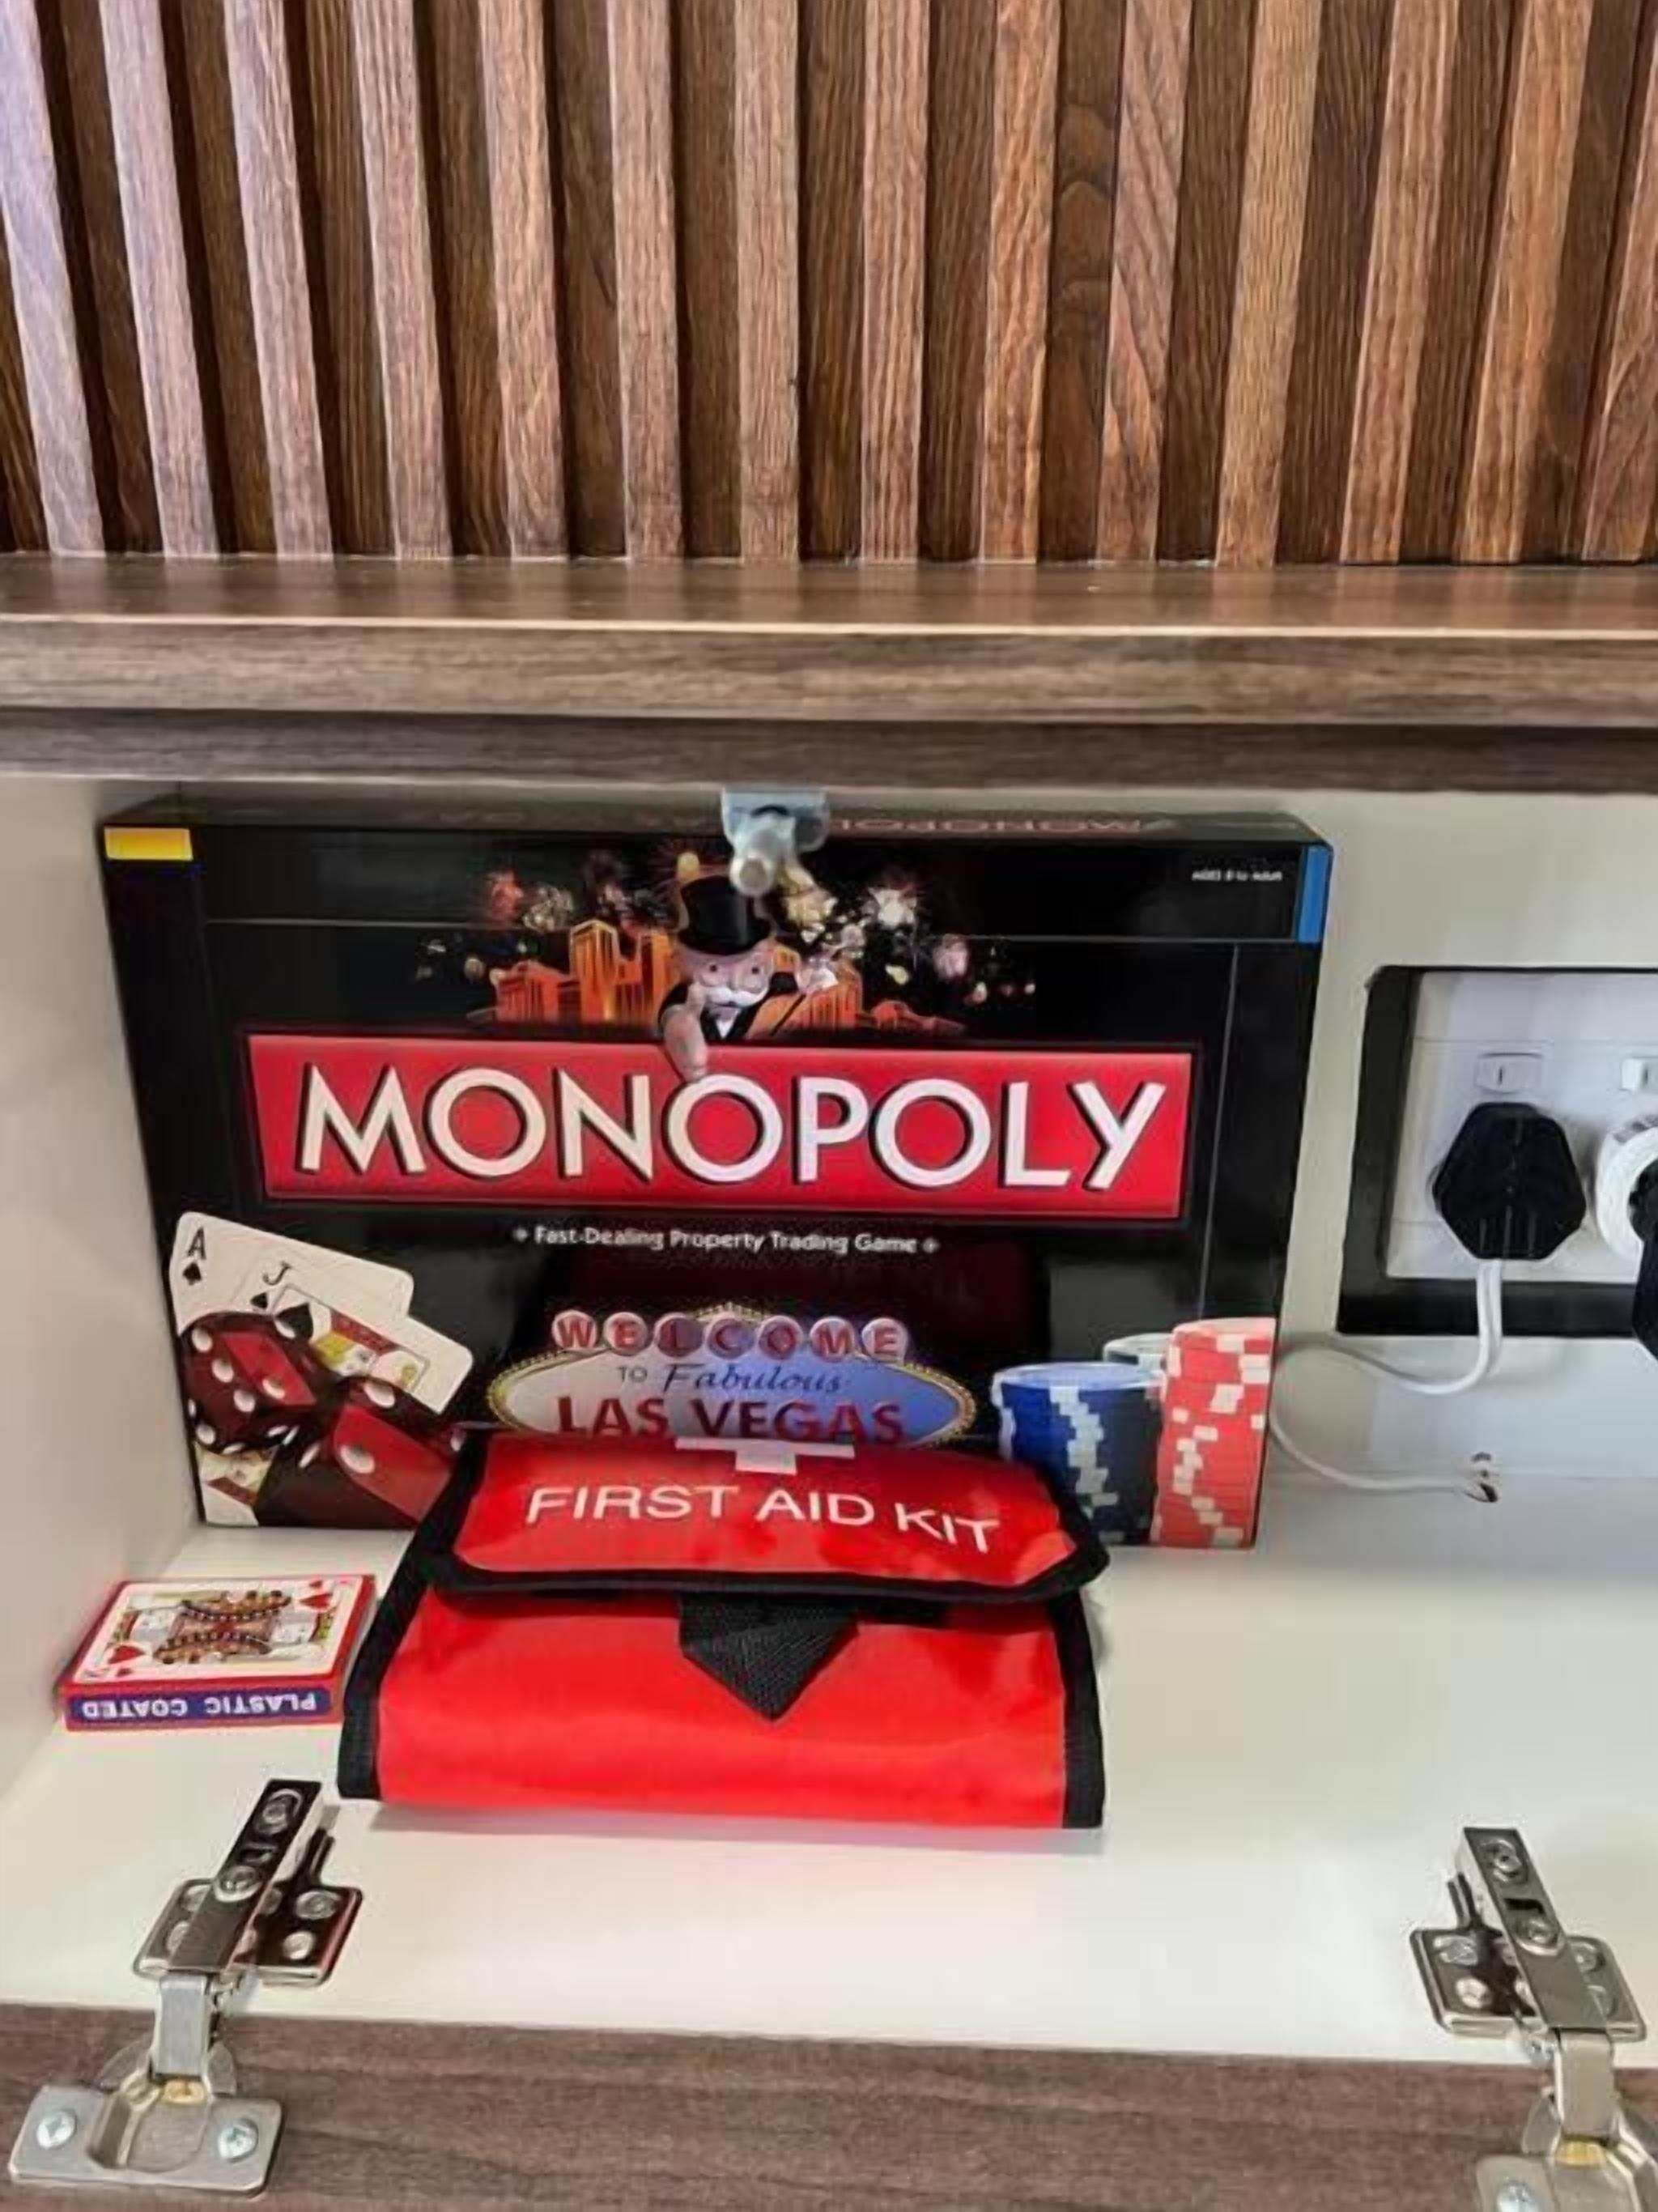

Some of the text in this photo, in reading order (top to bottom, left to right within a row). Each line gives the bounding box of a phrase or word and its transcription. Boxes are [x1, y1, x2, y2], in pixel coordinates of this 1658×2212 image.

[296, 1064, 1164, 1191] MONOPOLY
[186, 1226, 206, 1261] A
[533, 1225, 917, 1254] Fast-Dealing Property Trading Game
[557, 1314, 899, 1359] WELCOME
[619, 1363, 843, 1393] TO Fabulous
[557, 1394, 904, 1445] LAS VEGAS
[525, 1484, 1001, 1555] FIRST AID KIT
[82, 1691, 318, 1719] PLASTIC COATED
